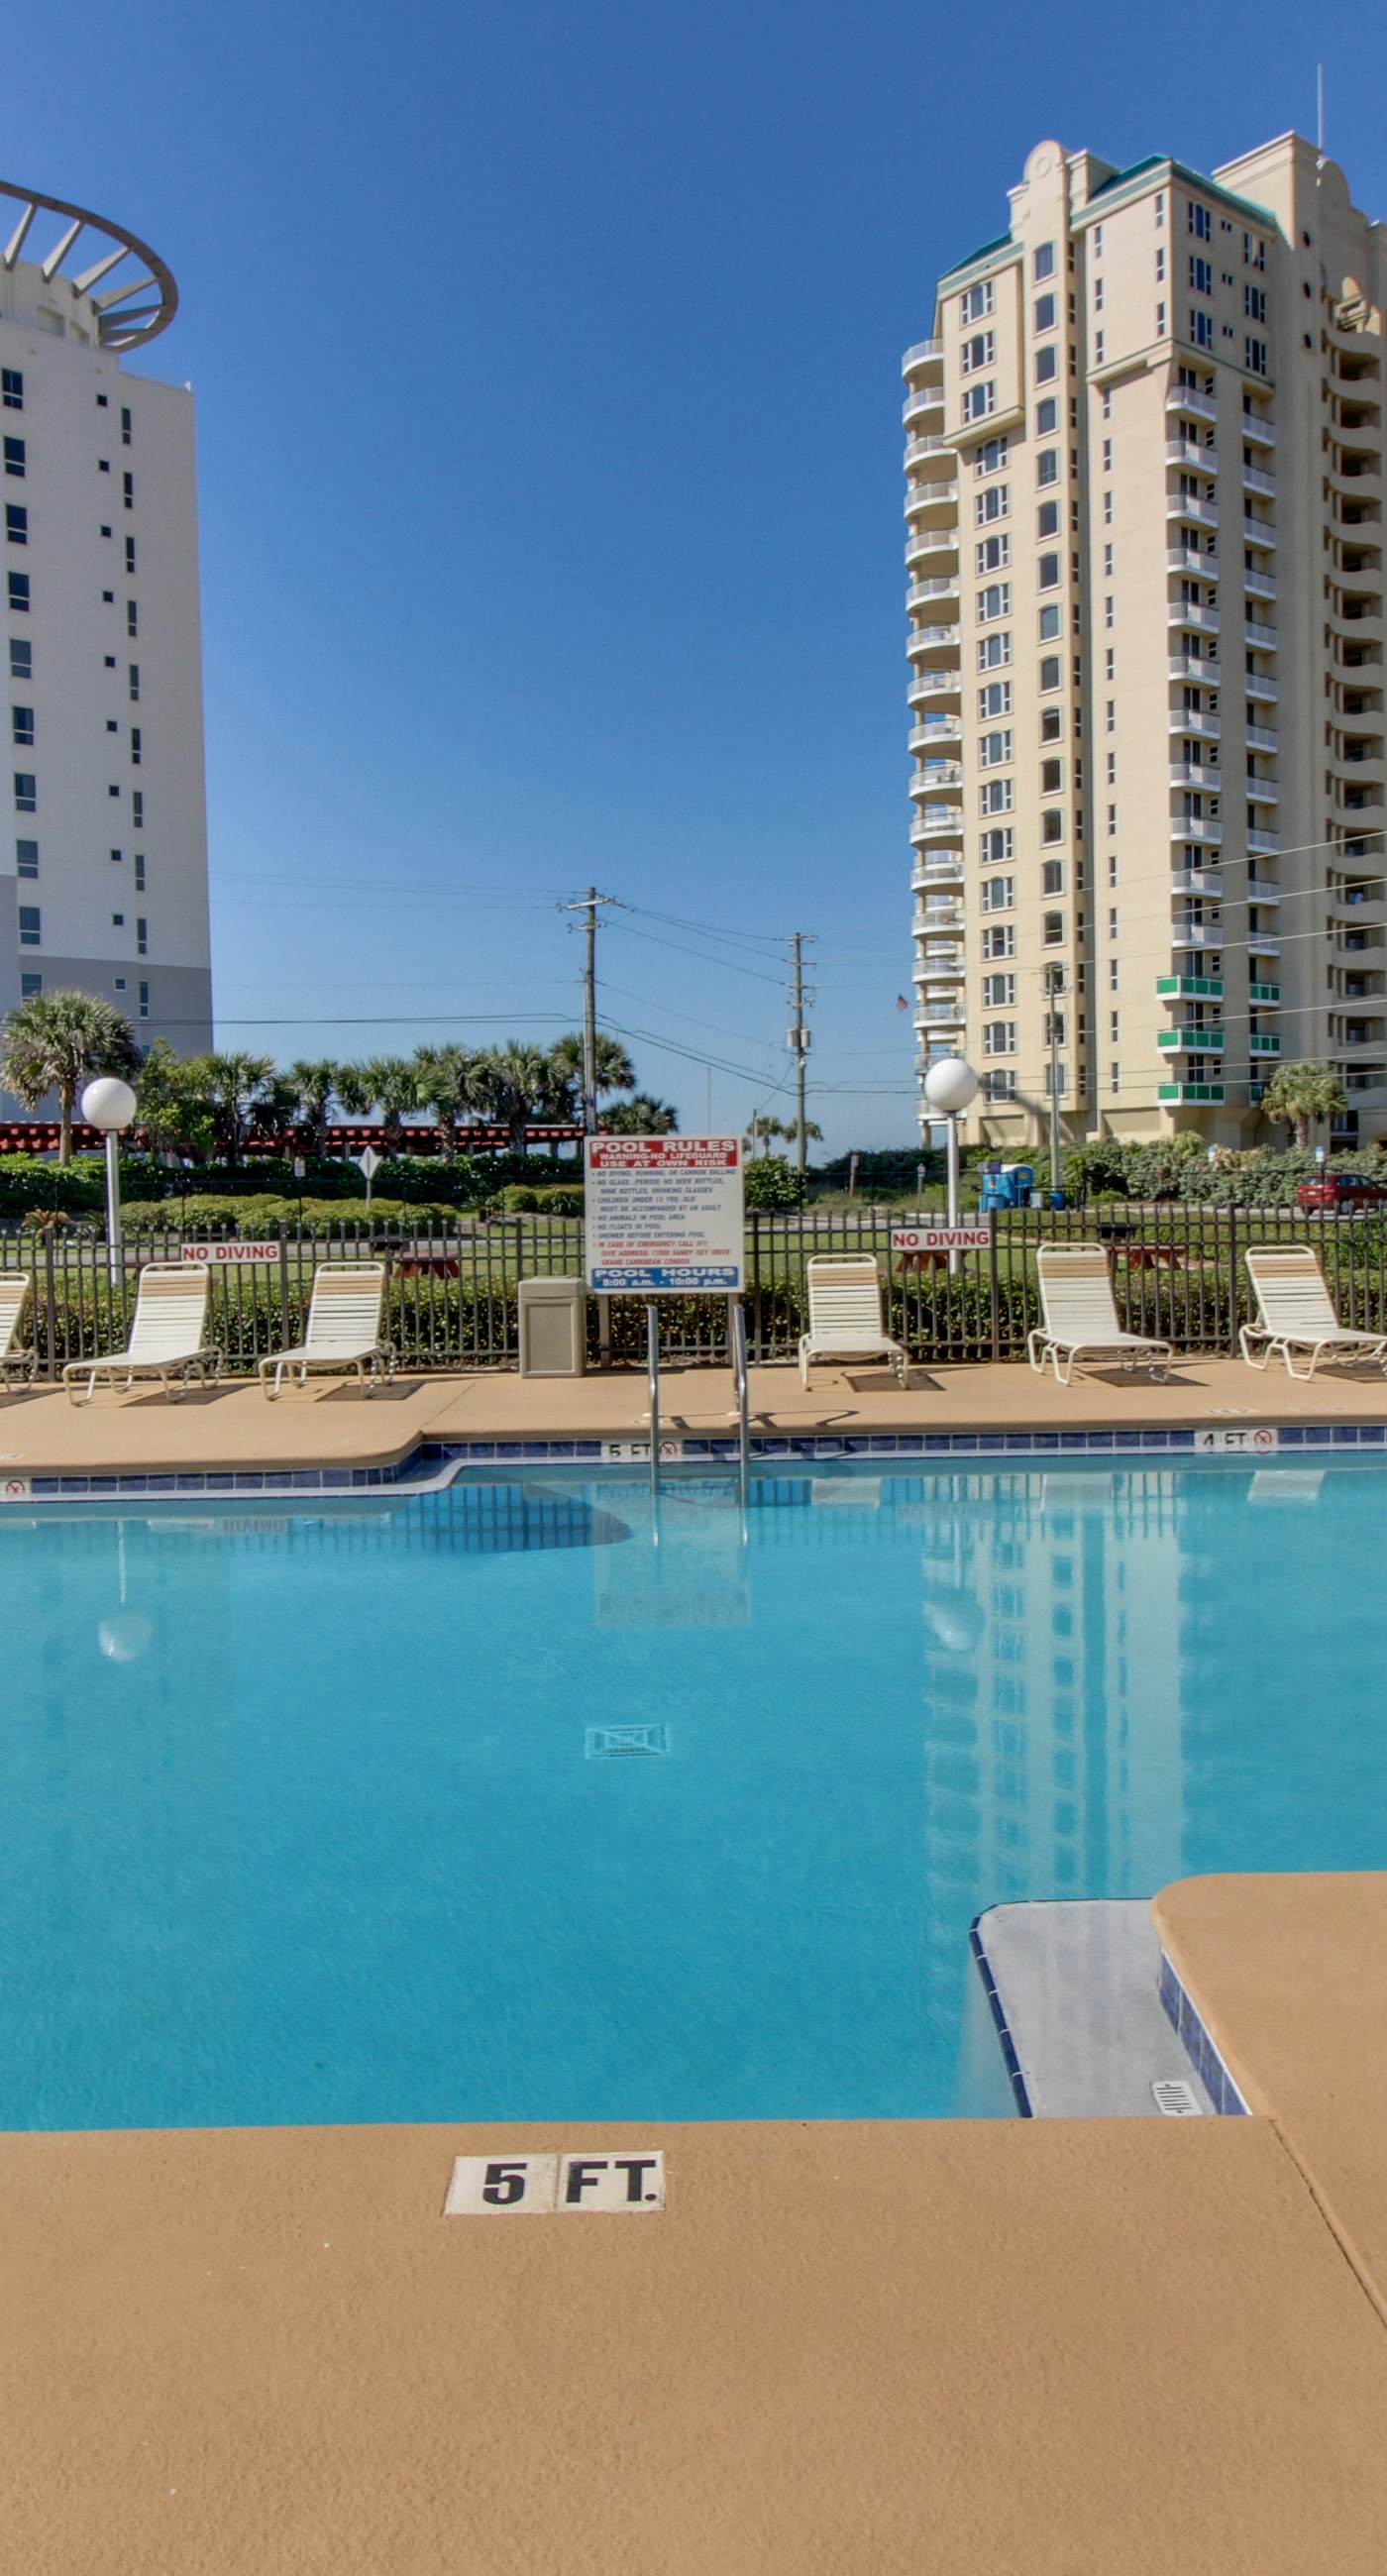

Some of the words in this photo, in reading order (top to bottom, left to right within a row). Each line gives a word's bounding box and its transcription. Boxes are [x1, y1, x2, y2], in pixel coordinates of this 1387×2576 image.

[591, 1141, 652, 1152] POOL
[663, 1140, 735, 1152] RULES
[893, 1233, 919, 1246] NO
[926, 1232, 989, 1246] DIVING
[183, 1246, 208, 1260] NO
[216, 1244, 277, 1259] DIVING
[1225, 1433, 1246, 1446] FT
[608, 1444, 620, 1456] 5
[482, 2162, 528, 2205] 5
[566, 2159, 657, 2203] FT.
